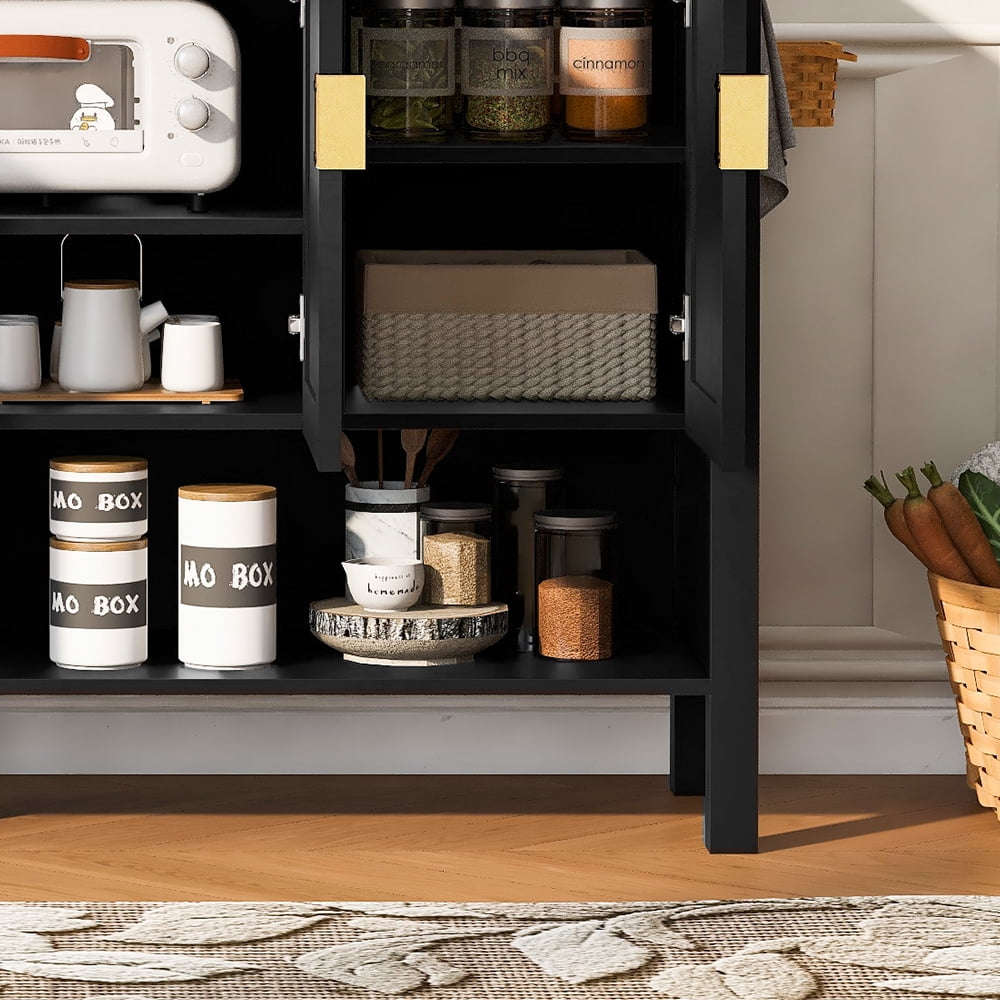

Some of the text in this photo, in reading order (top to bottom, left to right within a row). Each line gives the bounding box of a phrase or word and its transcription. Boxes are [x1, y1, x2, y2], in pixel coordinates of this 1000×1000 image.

[492, 48, 530, 65] bbq
[572, 57, 644, 70] cinnamon
[496, 65, 528, 79] mix
[52, 490, 143, 512] MO BOX
[183, 560, 274, 590] MO BOX
[52, 592, 140, 616] MO BOX
